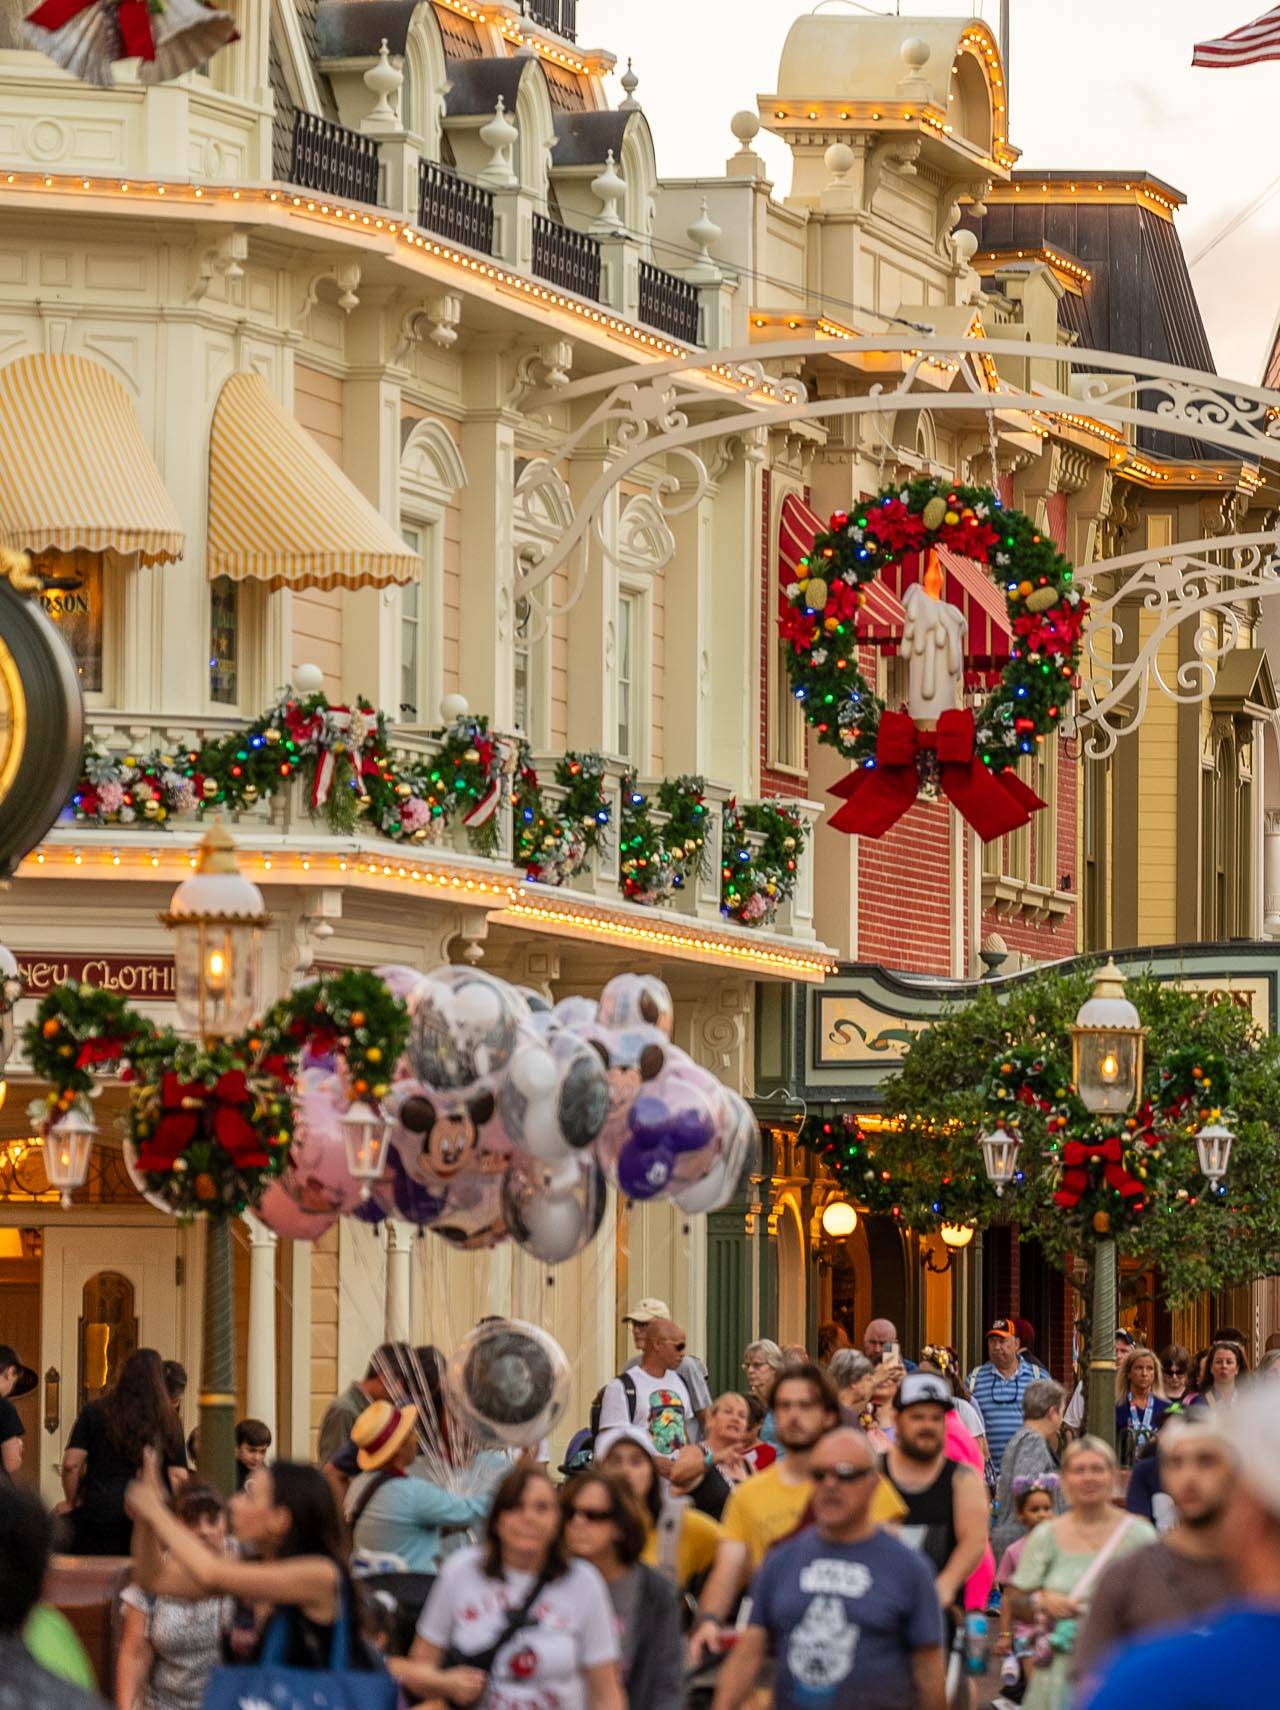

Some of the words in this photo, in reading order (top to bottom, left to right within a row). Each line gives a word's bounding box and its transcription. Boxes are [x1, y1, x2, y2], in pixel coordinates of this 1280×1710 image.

[41, 591, 88, 614] RSON
[17, 961, 69, 986] NEY
[82, 960, 176, 991] CLOTHI
